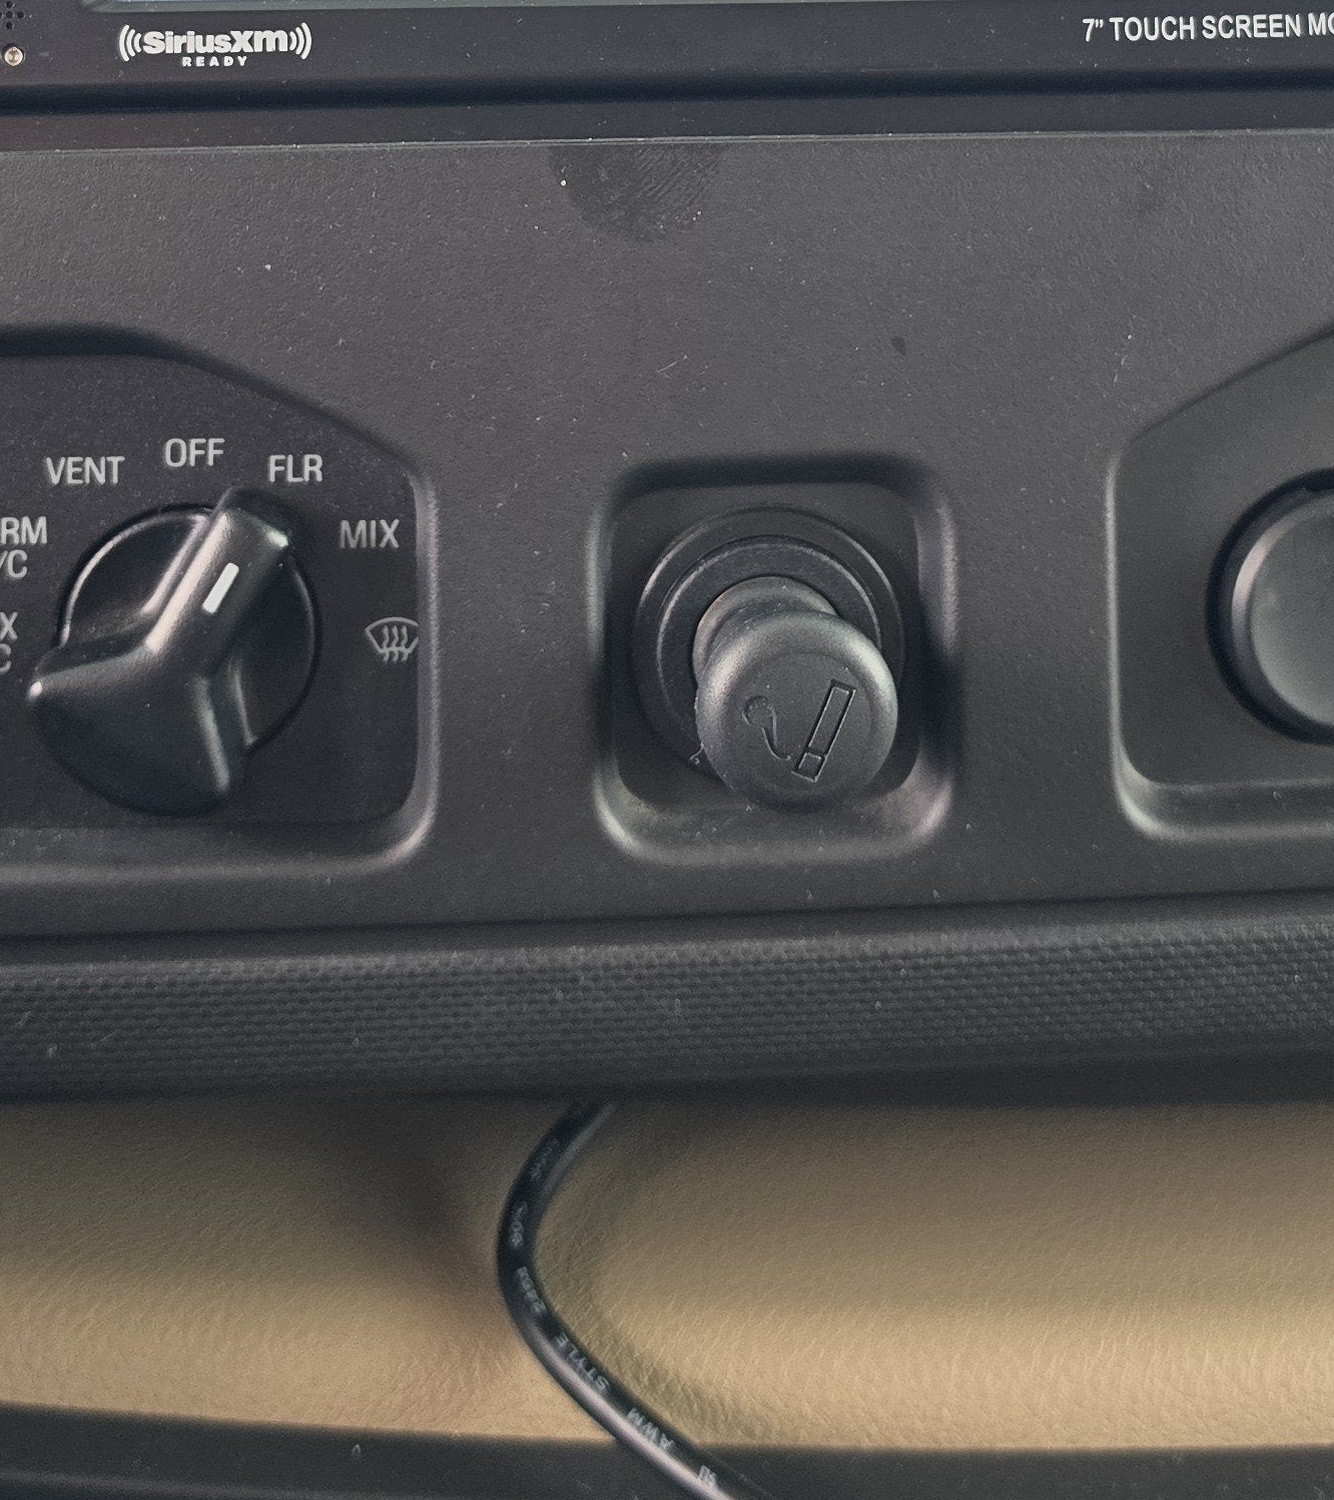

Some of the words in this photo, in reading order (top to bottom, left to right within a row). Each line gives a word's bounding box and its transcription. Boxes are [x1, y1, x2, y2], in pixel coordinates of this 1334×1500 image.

[1109, 16, 1195, 41] TOUCH
[1201, 13, 1301, 40] SCREEN
[182, 55, 248, 67] READY
[165, 438, 225, 467] OFF
[45, 456, 124, 485] VENT
[269, 454, 323, 483] FLR
[340, 519, 399, 549] MIX
